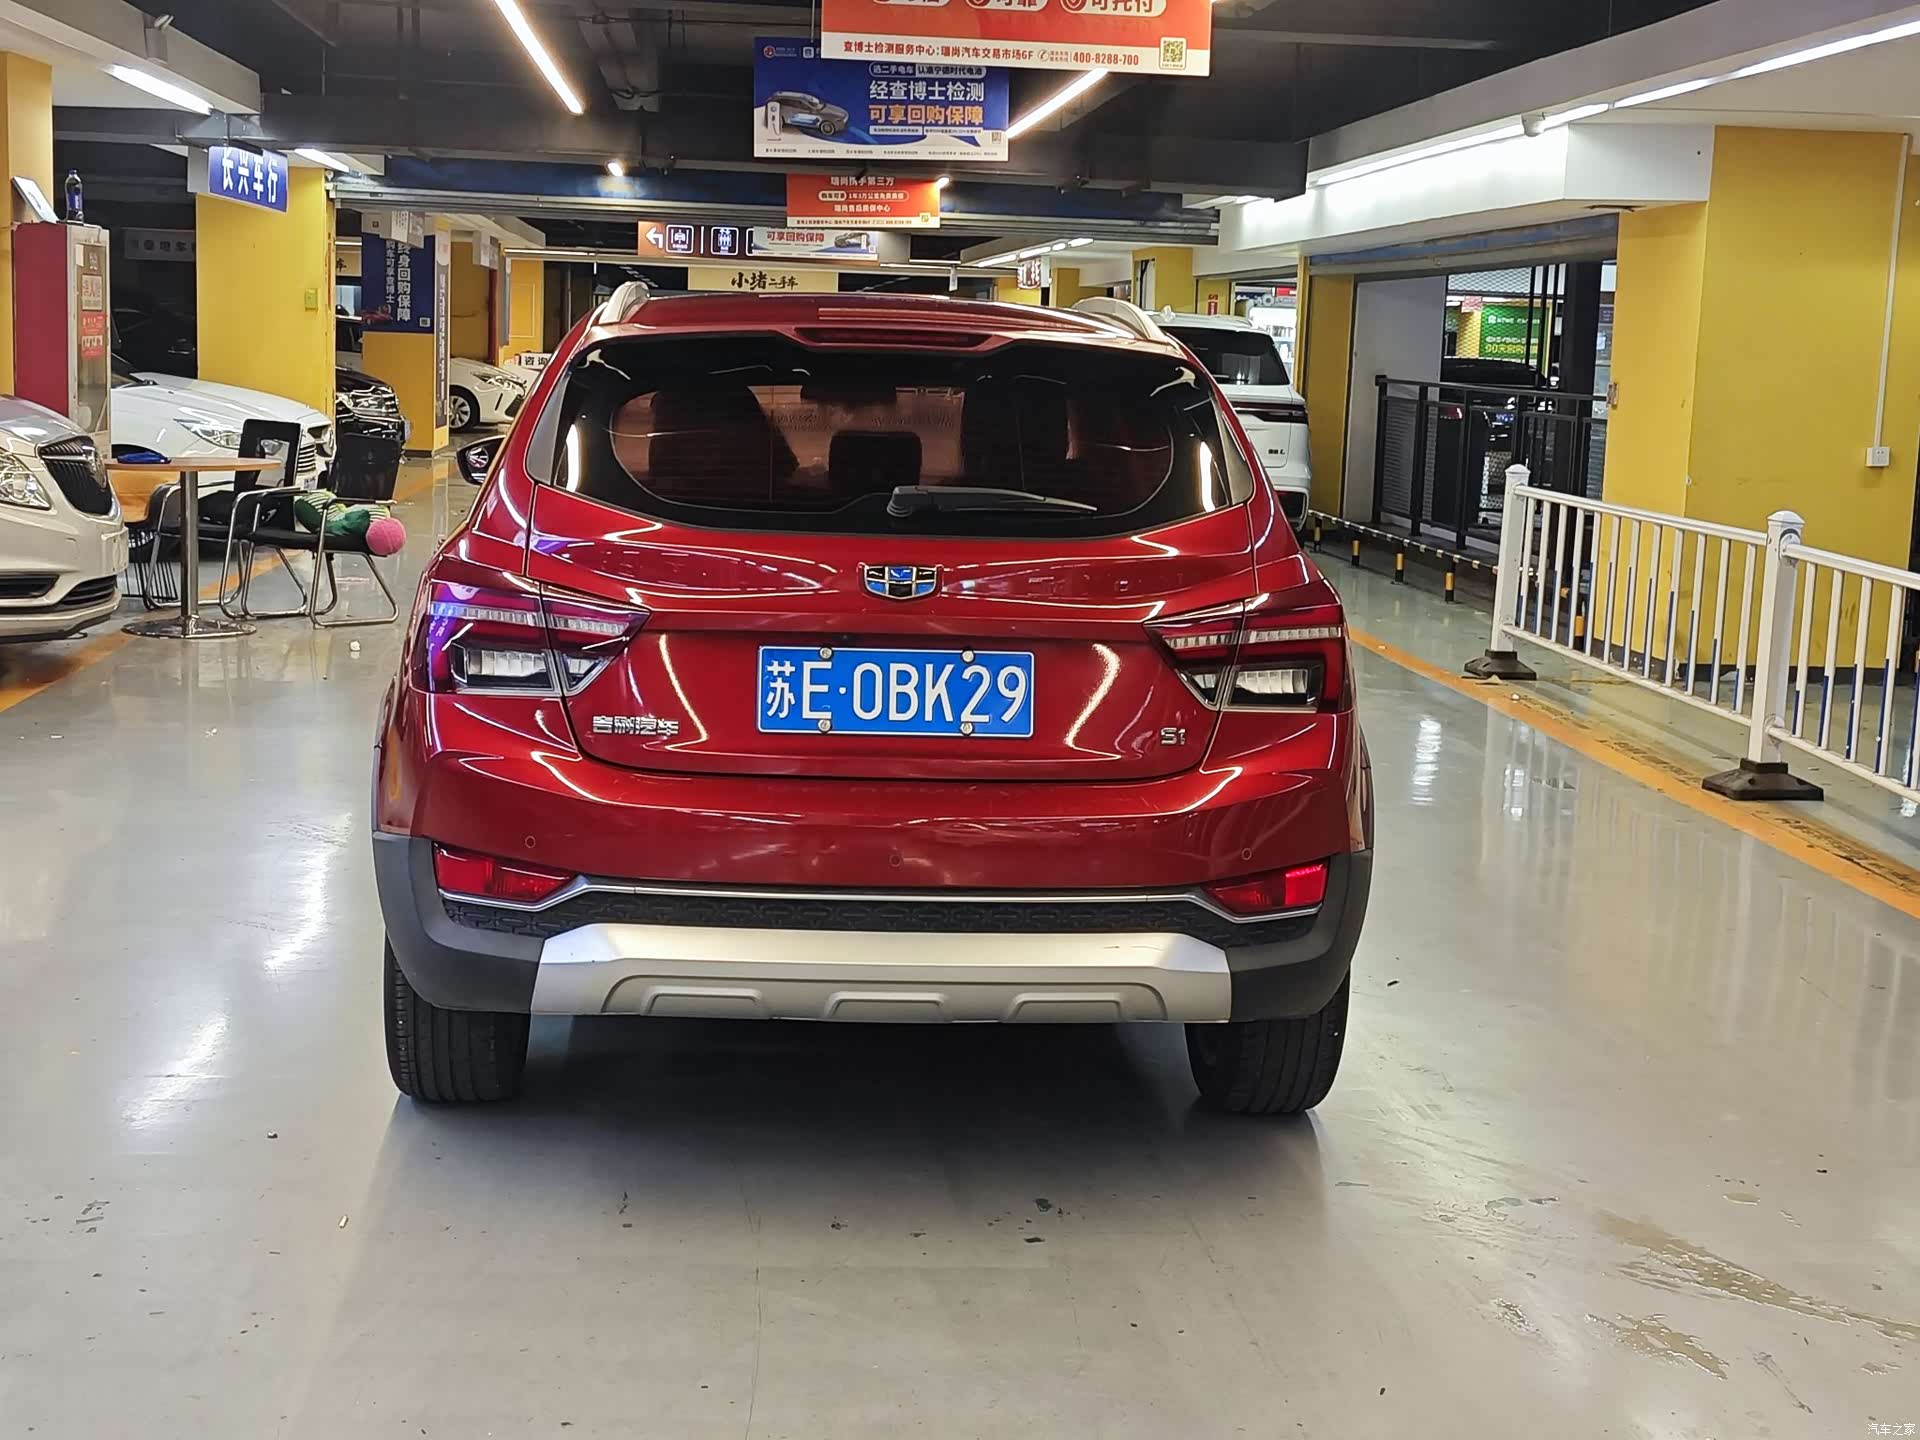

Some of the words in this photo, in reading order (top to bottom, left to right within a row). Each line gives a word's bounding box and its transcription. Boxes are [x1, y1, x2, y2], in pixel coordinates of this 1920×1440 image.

[1072, 51, 1139, 66] 400-8288-700
[869, 80, 984, 102] 经查博士检测
[869, 104, 984, 125] 可享回购保障
[222, 146, 278, 203] 长兴车行
[767, 231, 825, 243] 可享回购保障
[766, 659, 1028, 724] 苏E·0BK29
[592, 714, 679, 736] 吉利汽车
[1160, 727, 1186, 746] S1
